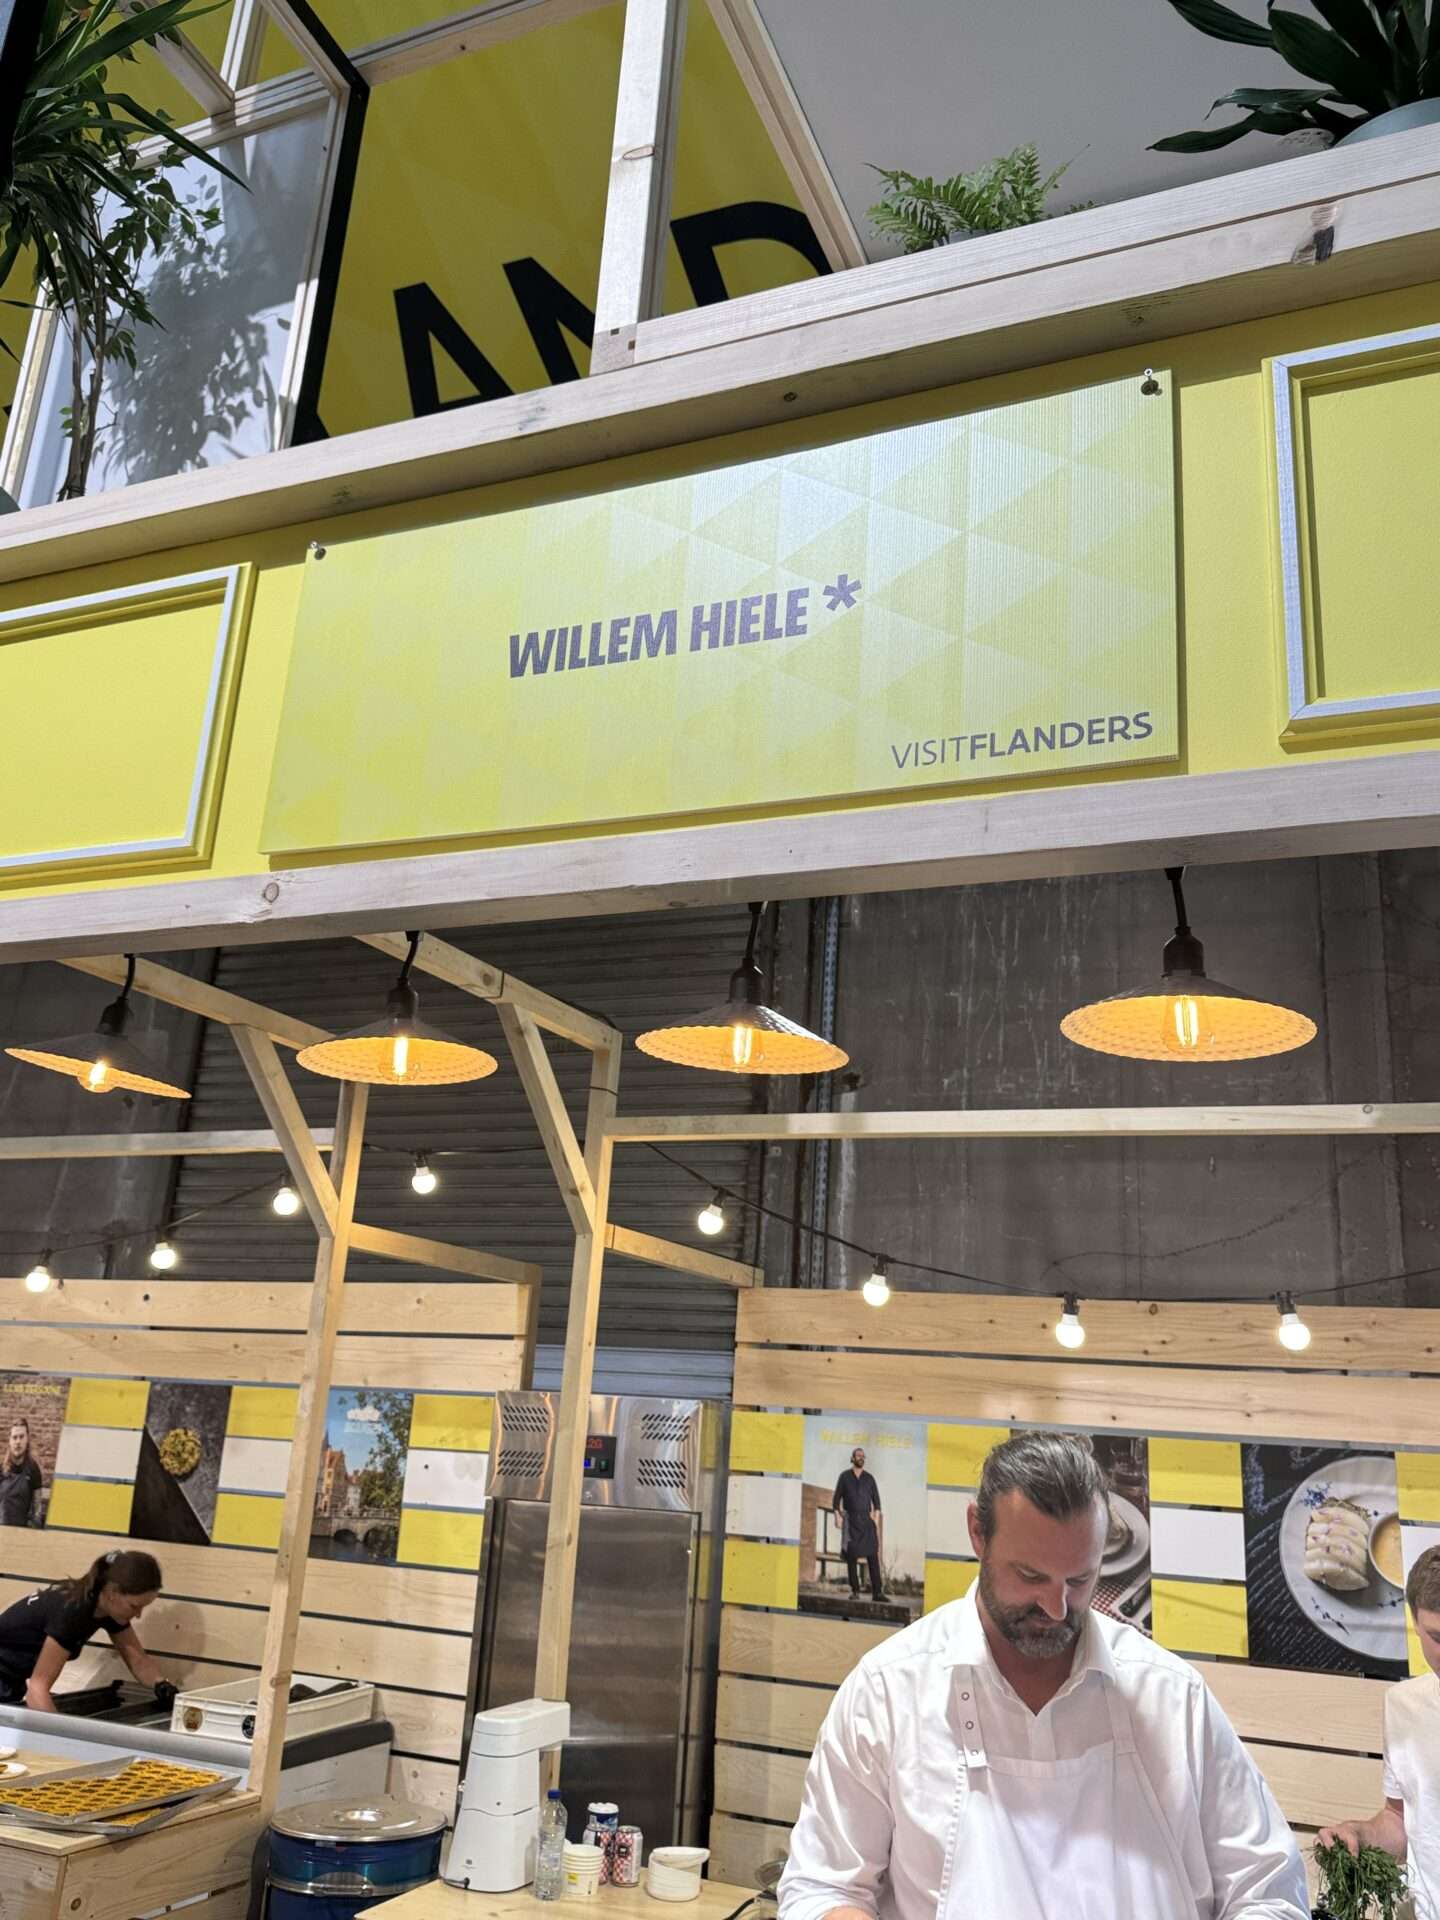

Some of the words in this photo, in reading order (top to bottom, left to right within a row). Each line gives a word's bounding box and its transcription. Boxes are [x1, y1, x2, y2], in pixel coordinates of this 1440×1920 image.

[510, 609, 678, 678] WILLEM
[689, 587, 810, 652] HIELE
[891, 711, 1154, 768] VISITFLANDERS
